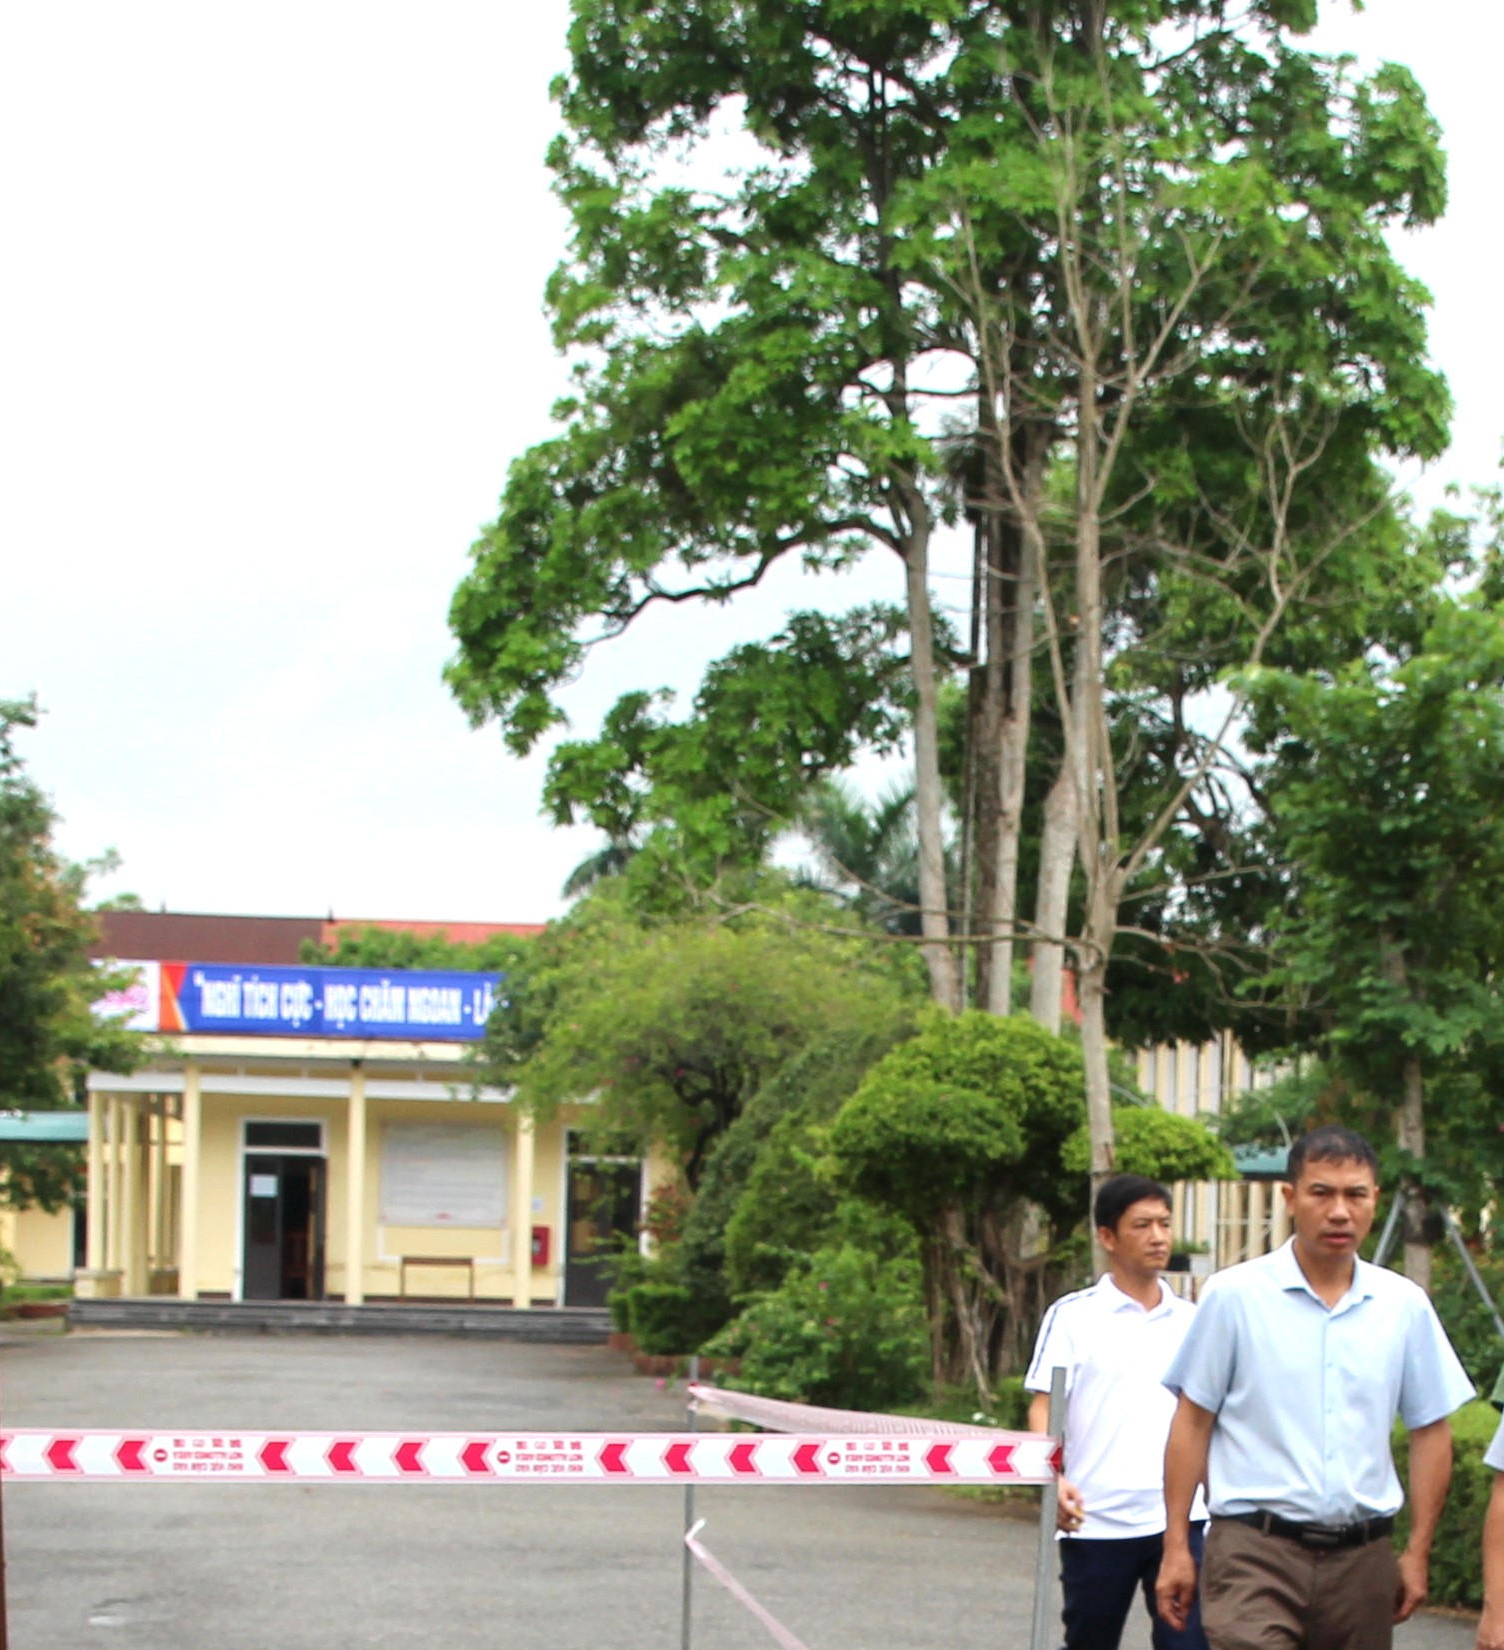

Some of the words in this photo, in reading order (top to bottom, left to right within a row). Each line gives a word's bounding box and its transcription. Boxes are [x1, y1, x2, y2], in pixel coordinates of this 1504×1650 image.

[243, 973, 279, 1019] TÍCH
[280, 980, 314, 1029] CỰC
[323, 983, 358, 1030] HỌC
[359, 978, 406, 1024] CHĂM
[407, 986, 463, 1025] NGOAN
